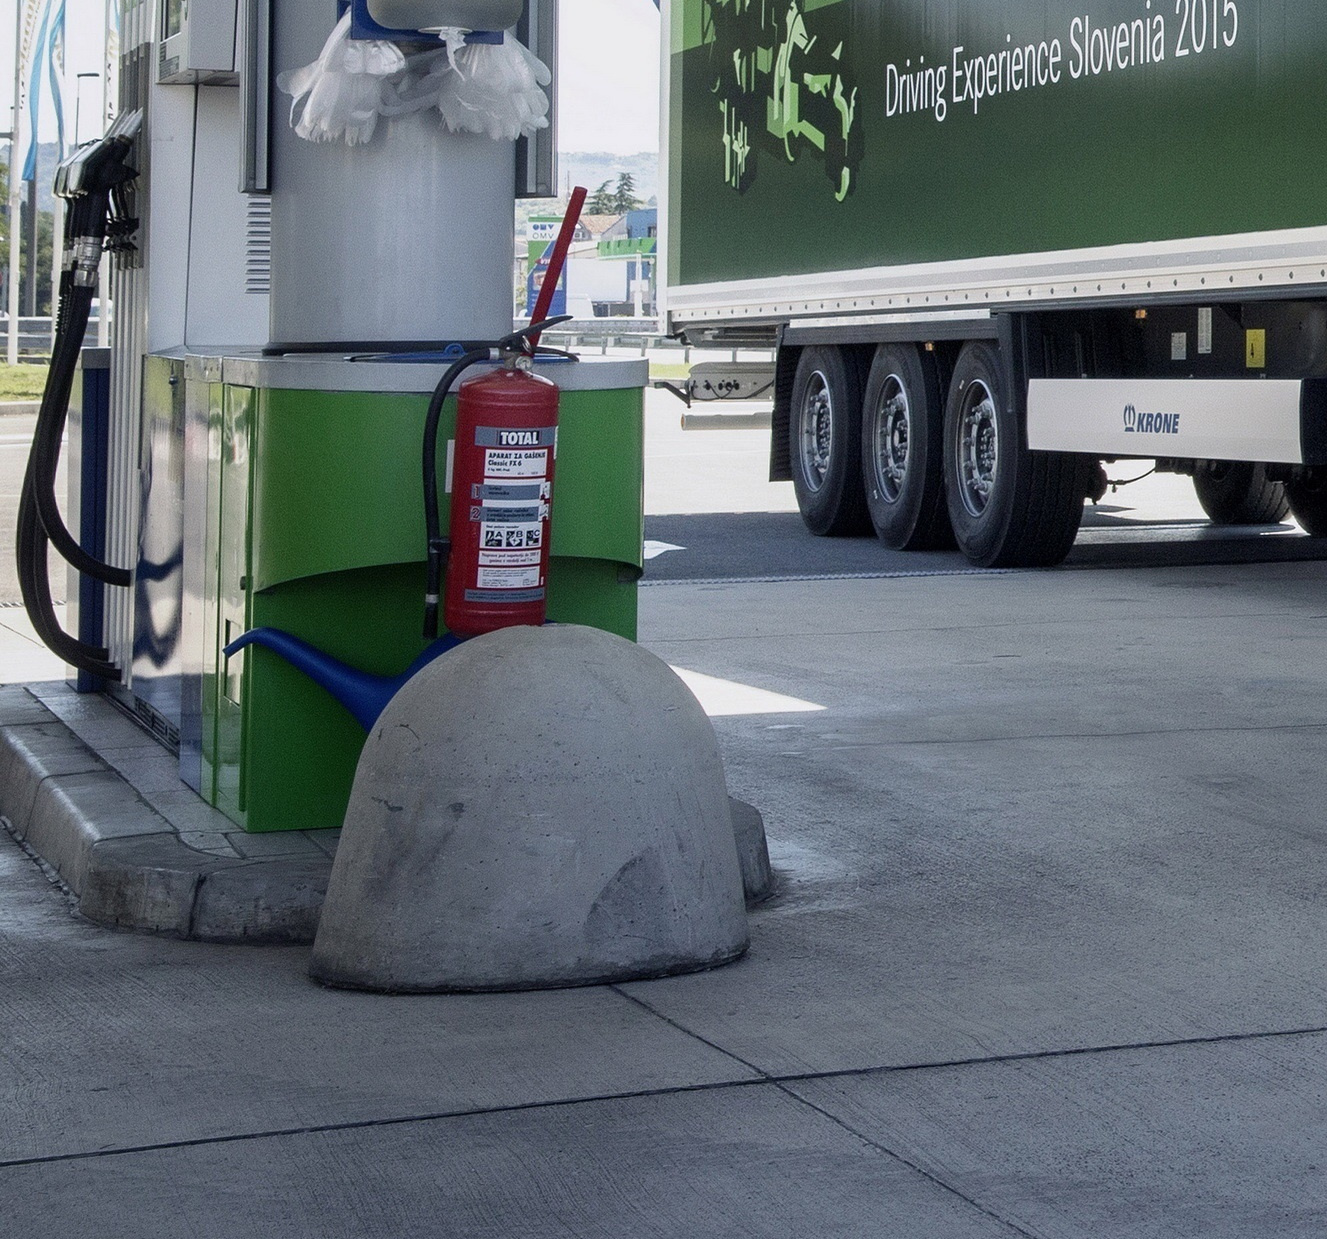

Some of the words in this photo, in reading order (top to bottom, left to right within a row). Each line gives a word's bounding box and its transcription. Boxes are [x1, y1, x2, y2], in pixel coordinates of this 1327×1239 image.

[886, 55, 947, 122] Driving
[952, 33, 1061, 115] Experience
[1069, 0, 1165, 79] Slovenia
[532, 232, 555, 240] OMV
[1136, 412, 1180, 434] KRONE
[500, 432, 539, 446] TOTAL
